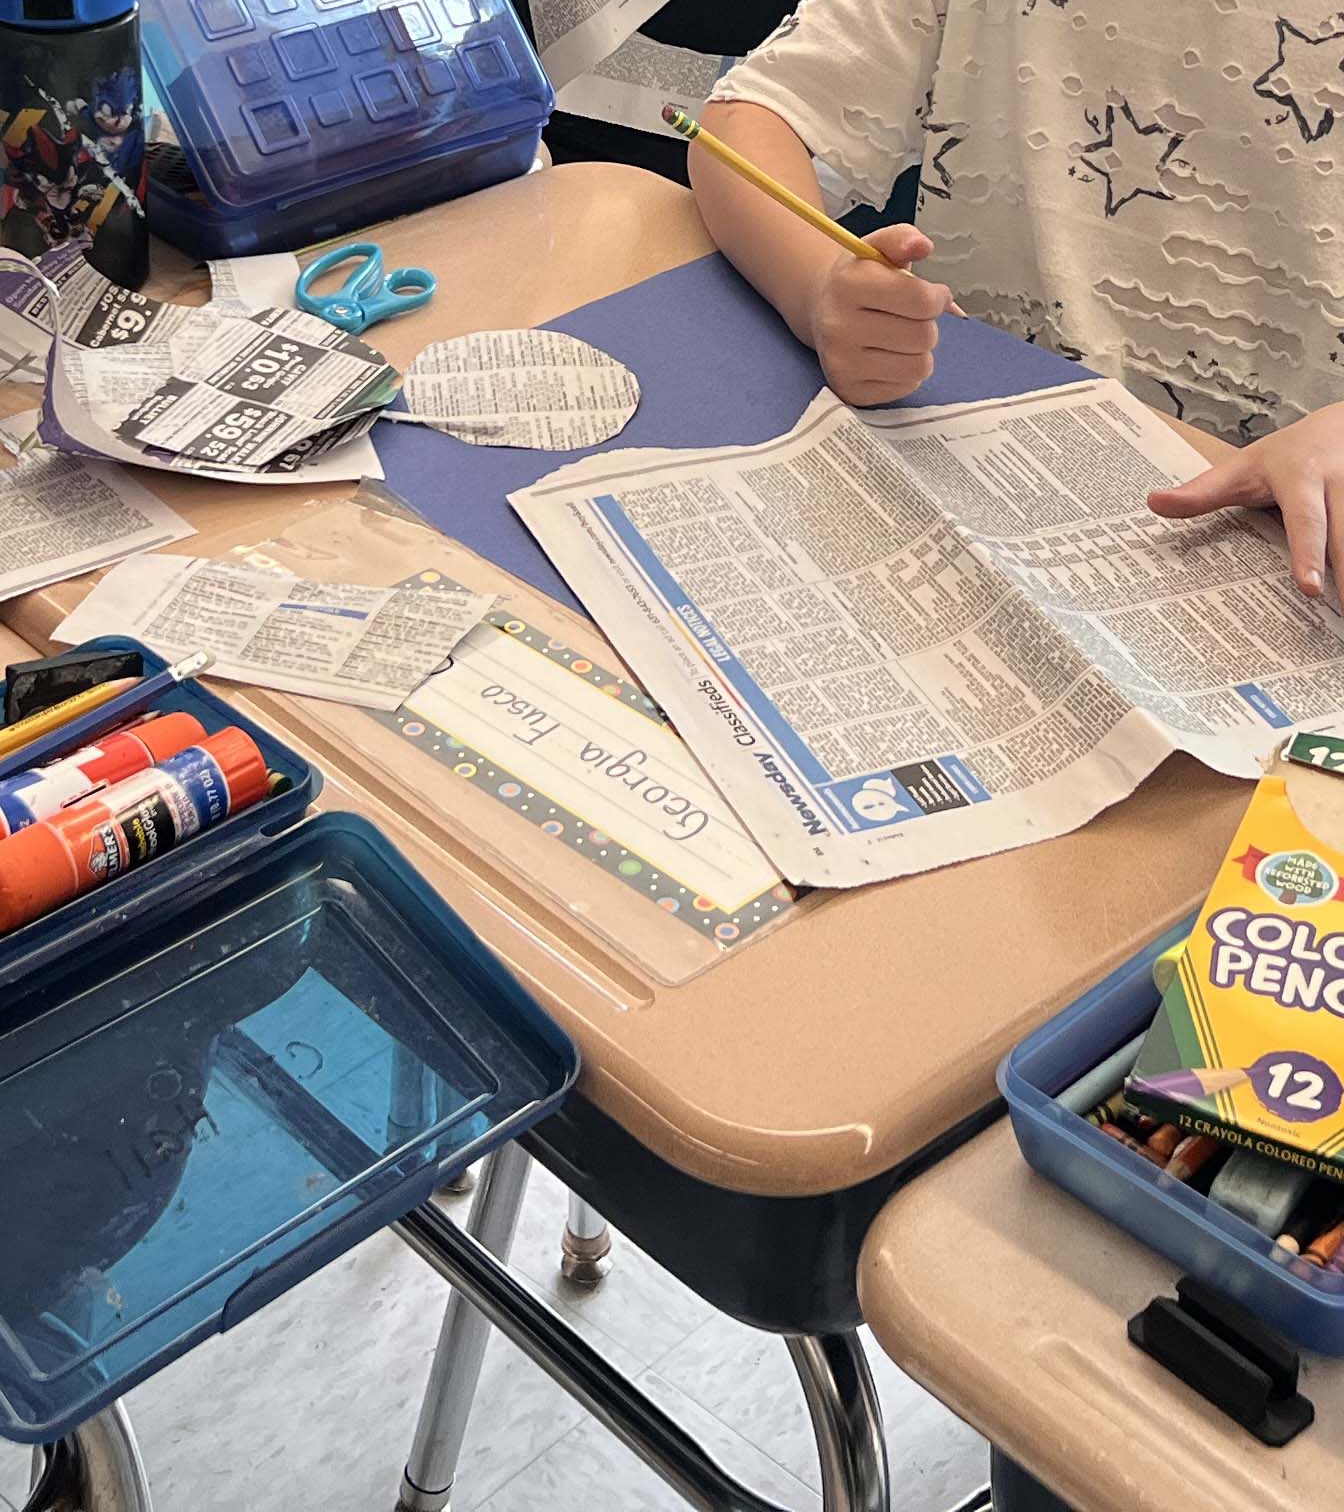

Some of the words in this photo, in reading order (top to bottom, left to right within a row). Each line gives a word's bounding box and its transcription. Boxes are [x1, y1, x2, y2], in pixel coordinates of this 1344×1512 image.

[90, 303, 122, 347] Cabernet
[676, 604, 712, 638] NOTICES
[702, 635, 731, 662] LEGAL
[480, 685, 561, 746] Fusco
[698, 678, 756, 747] Classifieds
[578, 740, 709, 841] Georgia
[753, 751, 831, 837] Newsday
[1264, 867, 1331, 892] REFORESTED
[1285, 864, 1316, 880] WITH
[1287, 856, 1319, 871] MADE
[1276, 879, 1312, 895] WOOD
[1267, 1061, 1326, 1112] 12
[1178, 1112, 1193, 1129] 12
[1194, 1117, 1254, 1151] CRAYOLA
[1255, 1139, 1317, 1173] COLORED
